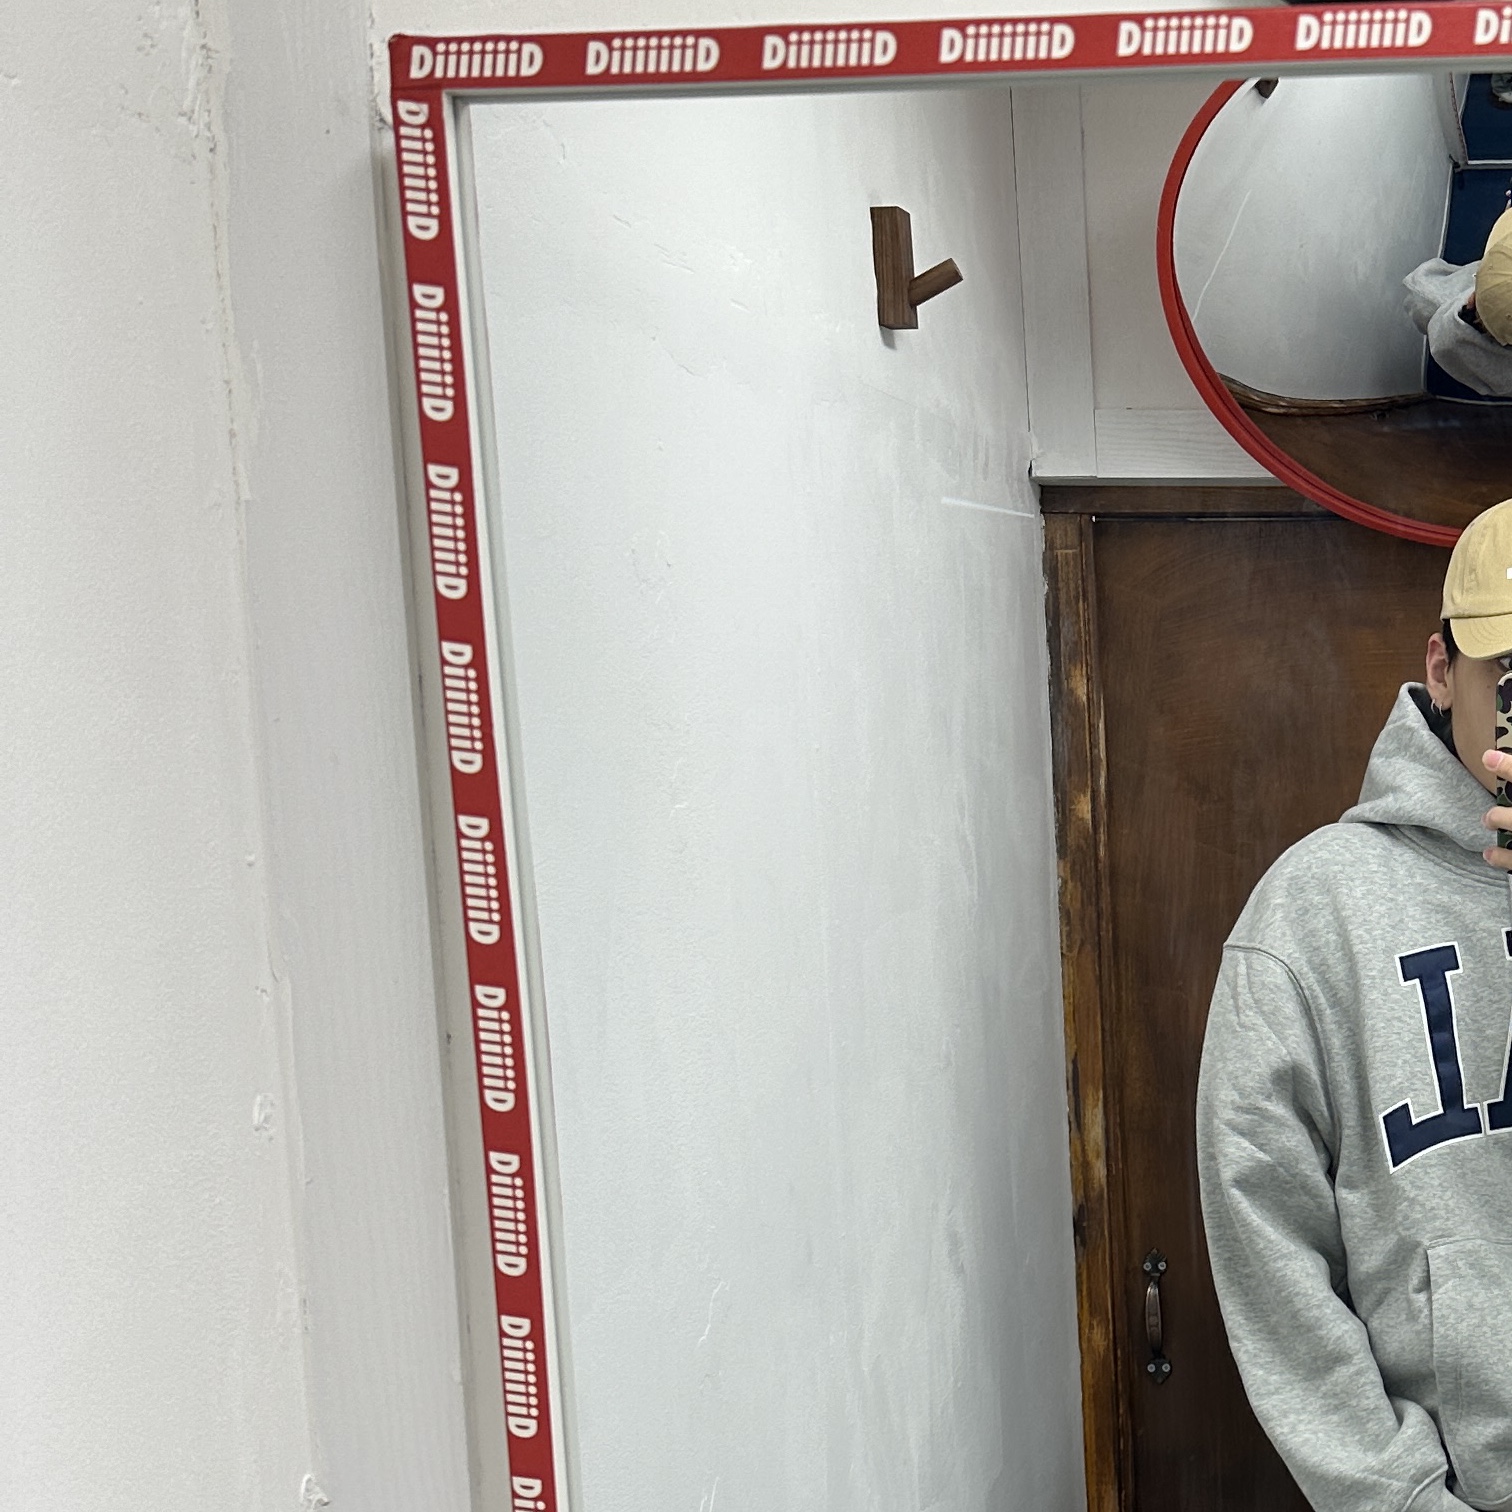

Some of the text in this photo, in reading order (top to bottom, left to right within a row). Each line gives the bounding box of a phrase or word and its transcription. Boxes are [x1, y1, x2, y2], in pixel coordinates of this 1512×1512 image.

[409, 40, 543, 79] DiiiiiiiD
[585, 35, 720, 75] DiiiiiiiD
[762, 29, 897, 70] DiiiiiiiD
[939, 22, 1075, 63] DiiiiiiiD
[1116, 15, 1254, 57] DiiiiiiiD
[1295, 9, 1432, 51] DiiiiiiiD
[397, 100, 441, 240] DiiiiiiiD
[412, 283, 456, 421] DiiiiiiiD
[428, 463, 469, 599] DiiiiiiiD
[444, 641, 484, 773] DiiiiiiiD
[459, 815, 502, 944] DiiiiiiiD
[474, 984, 517, 1112] DiiiiiiiD
[488, 1151, 529, 1276] DiiiiiiiD
[502, 1315, 539, 1438] DiiiiiiiD
